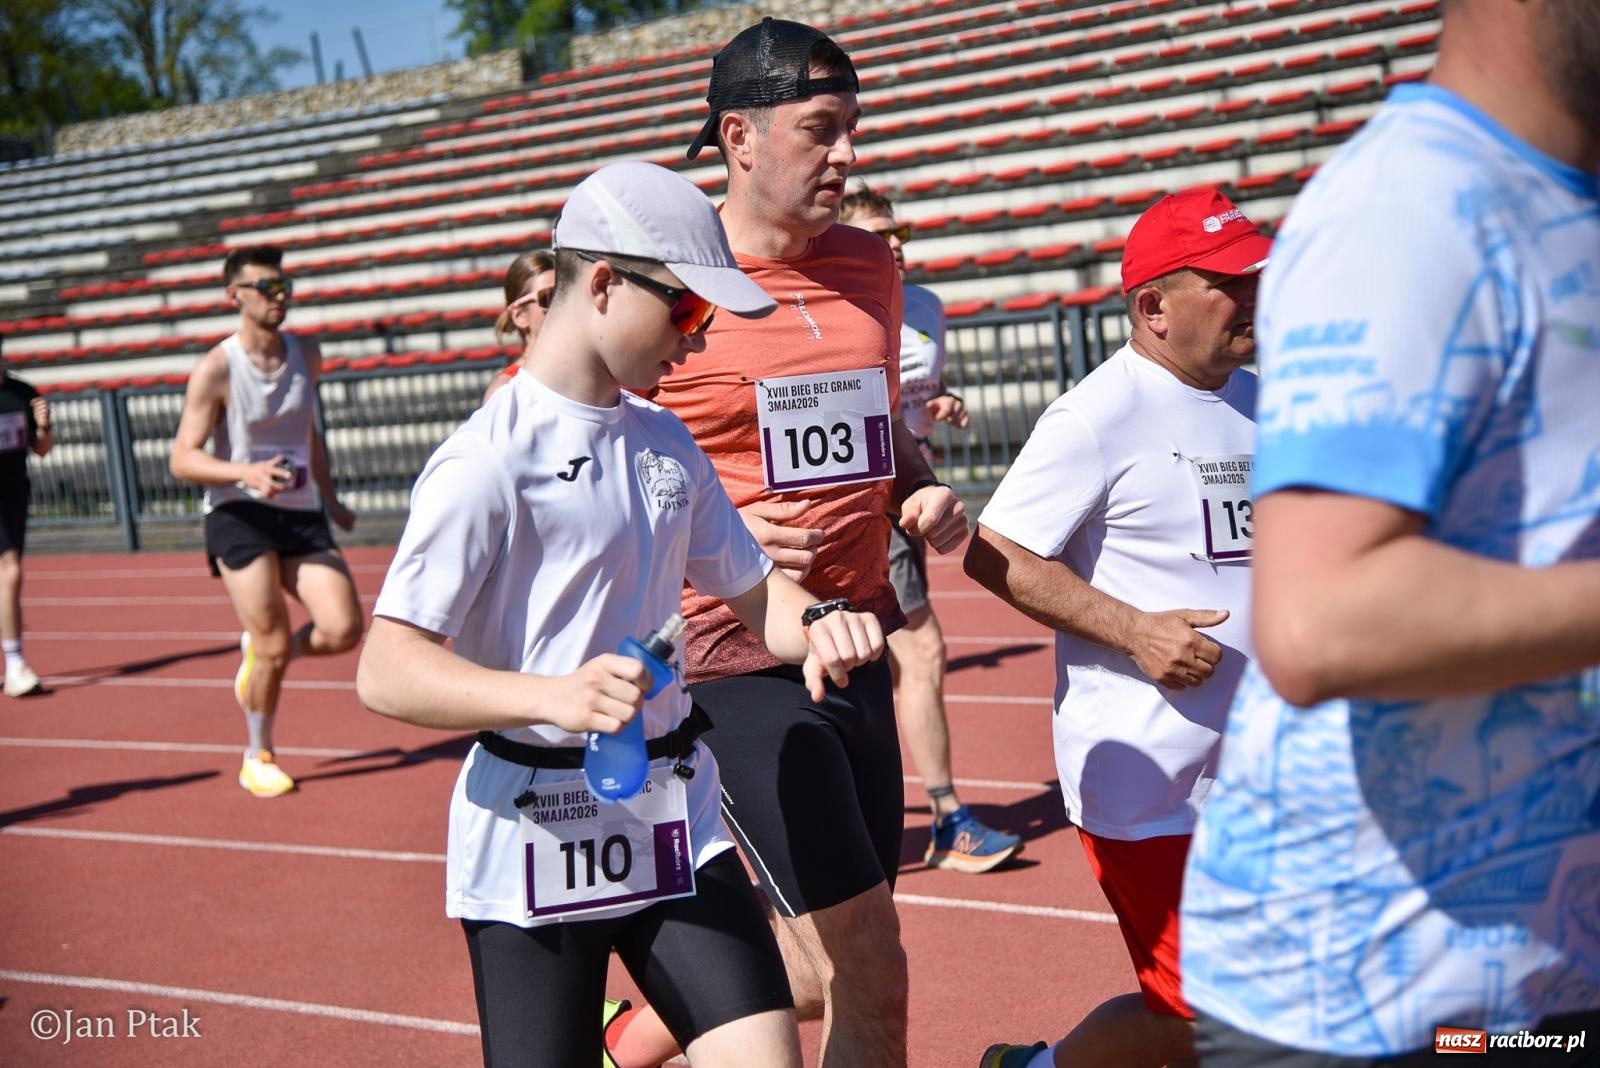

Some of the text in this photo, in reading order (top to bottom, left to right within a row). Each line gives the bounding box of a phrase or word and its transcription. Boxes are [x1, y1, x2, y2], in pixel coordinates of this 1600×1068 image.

[767, 378, 862, 399] XVIII BIEG BEZ GRANIC
[768, 396, 819, 412] 3MAJA2026
[784, 422, 854, 469] 103
[1197, 462, 1219, 474] XVIII
[1220, 461, 1237, 473] BIEG
[1239, 461, 1251, 472] BEZ
[1201, 474, 1245, 486] 3MAJA2026
[532, 793, 559, 809] XVIII
[564, 790, 589, 806] BIEG
[533, 804, 598, 825] 3MAJA2026
[559, 834, 633, 890] 110
